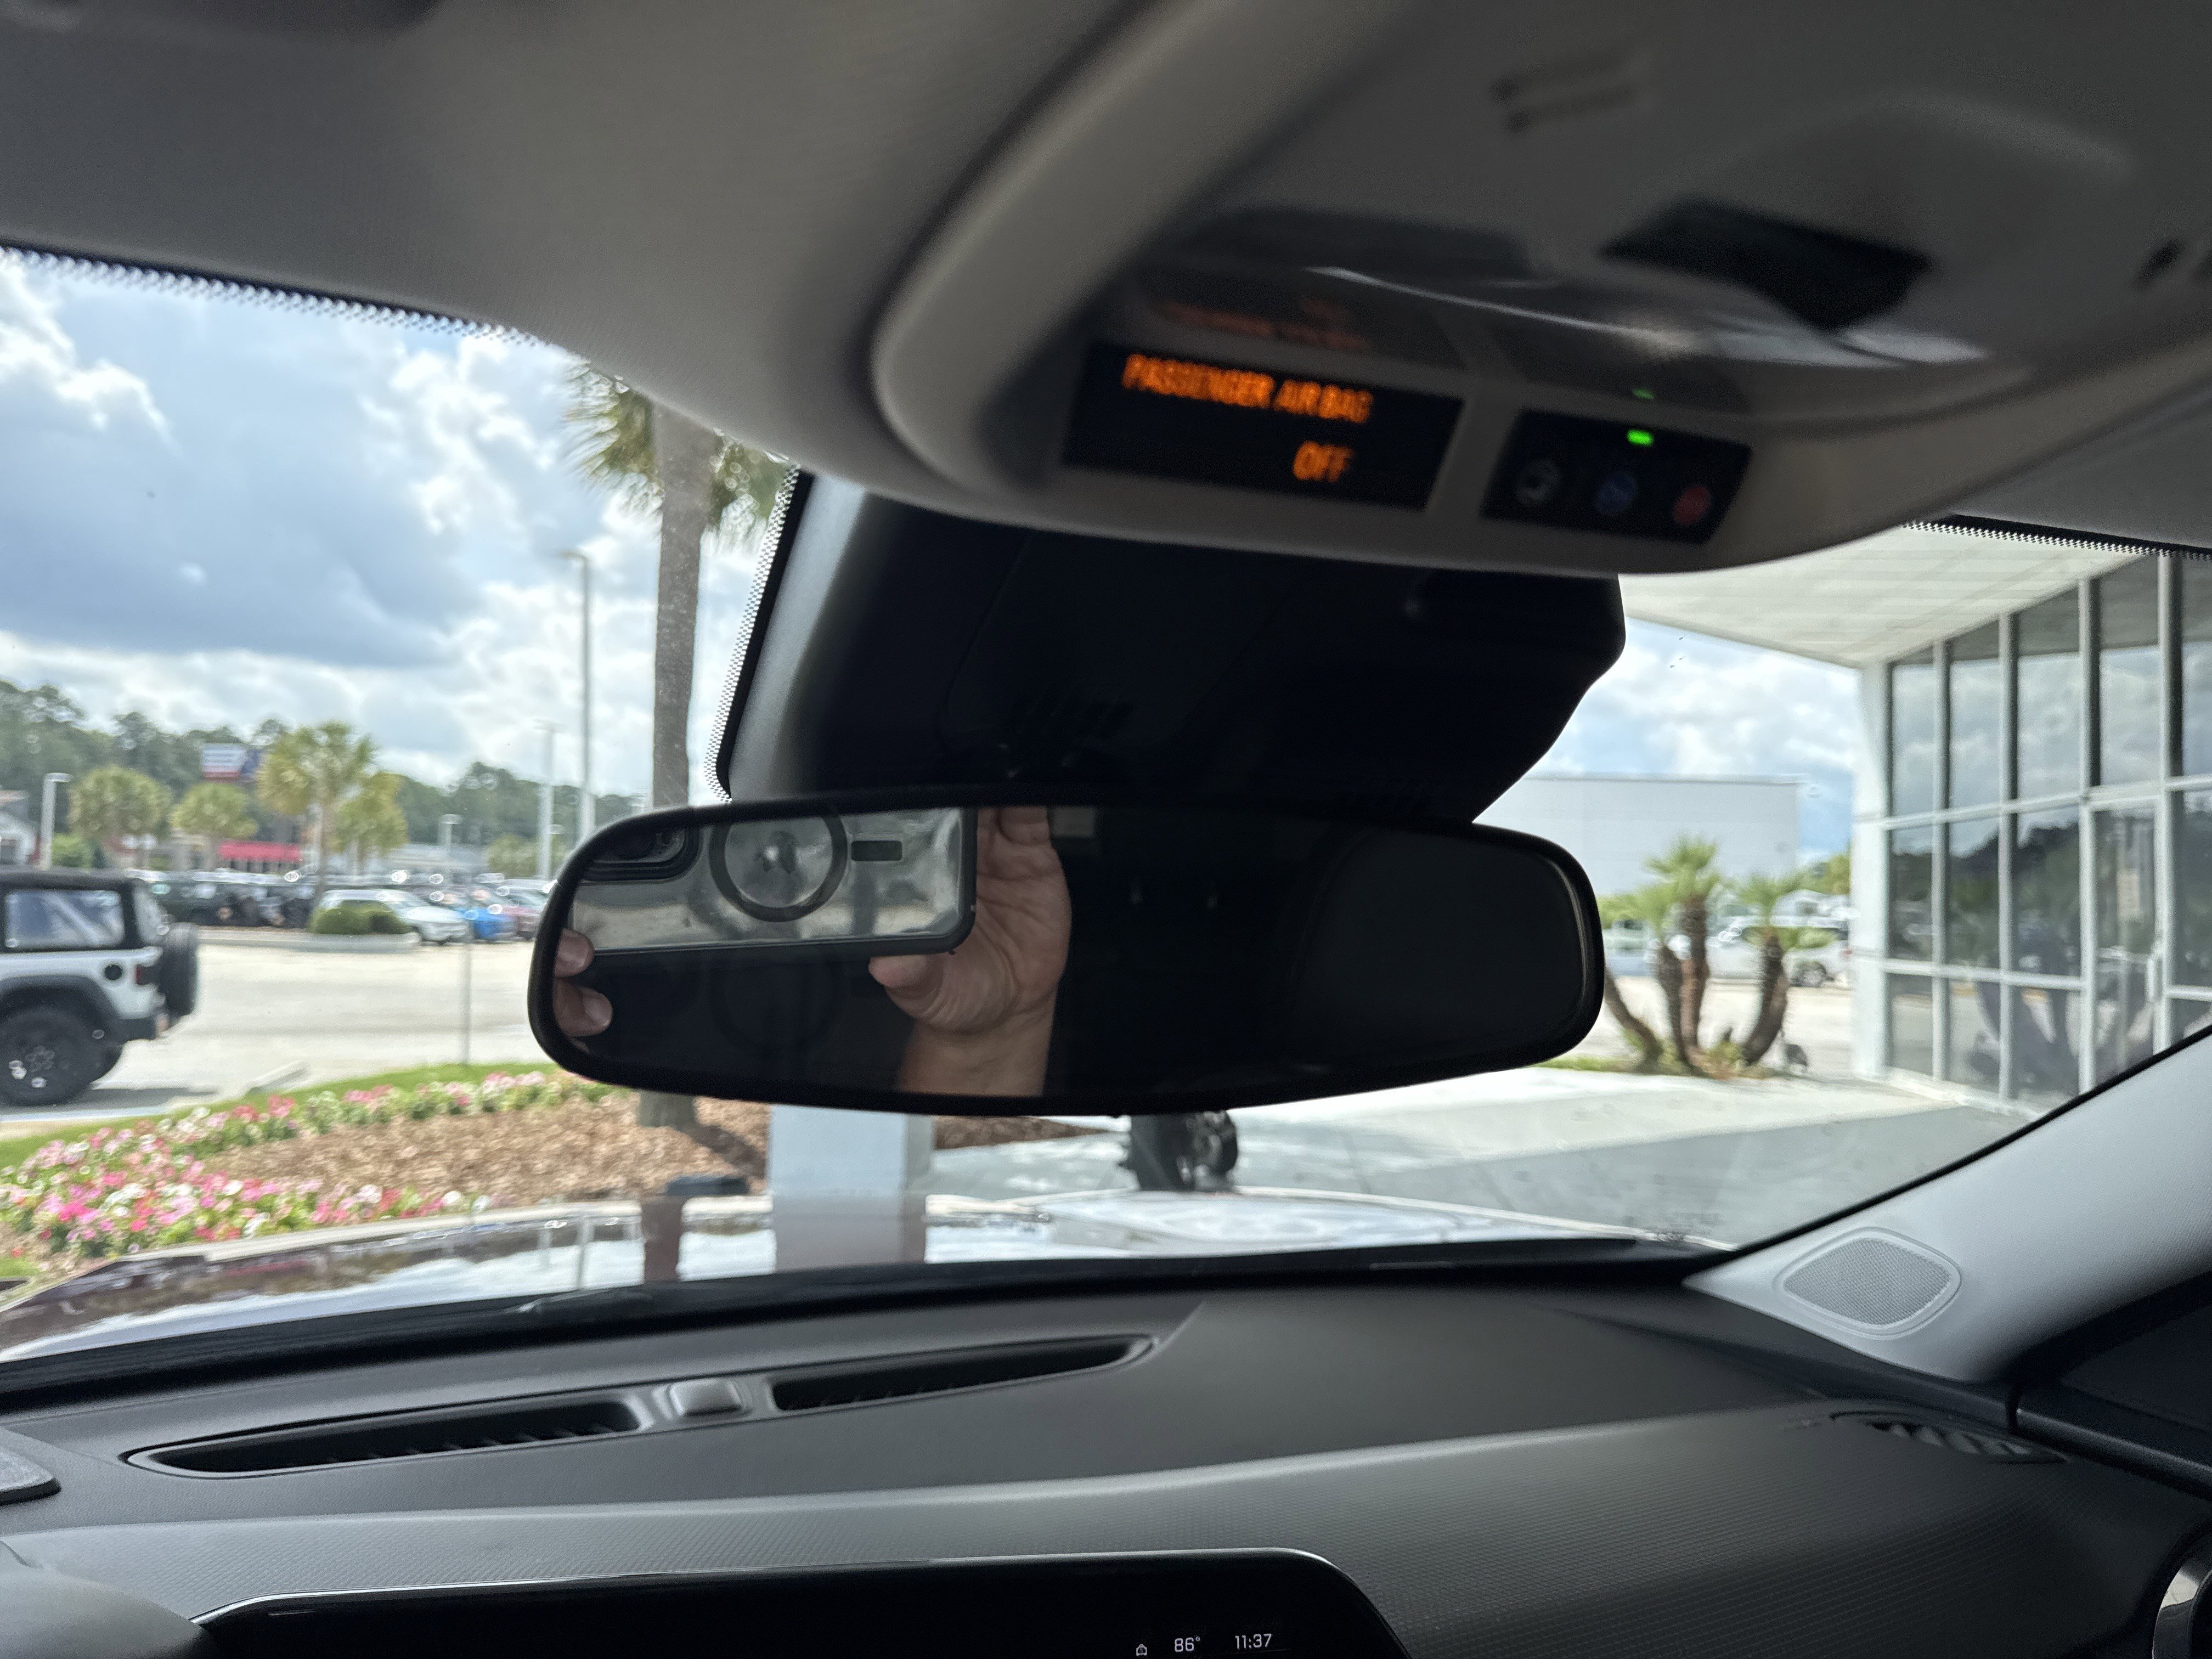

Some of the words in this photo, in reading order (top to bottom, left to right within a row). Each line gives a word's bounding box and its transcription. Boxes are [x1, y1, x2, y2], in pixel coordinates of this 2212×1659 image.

[1122, 353, 1274, 408] PASSENGER
[1293, 441, 1354, 481] OFF
[1174, 1636, 1200, 1652] 86°
[1235, 1633, 1272, 1649] 11:37
